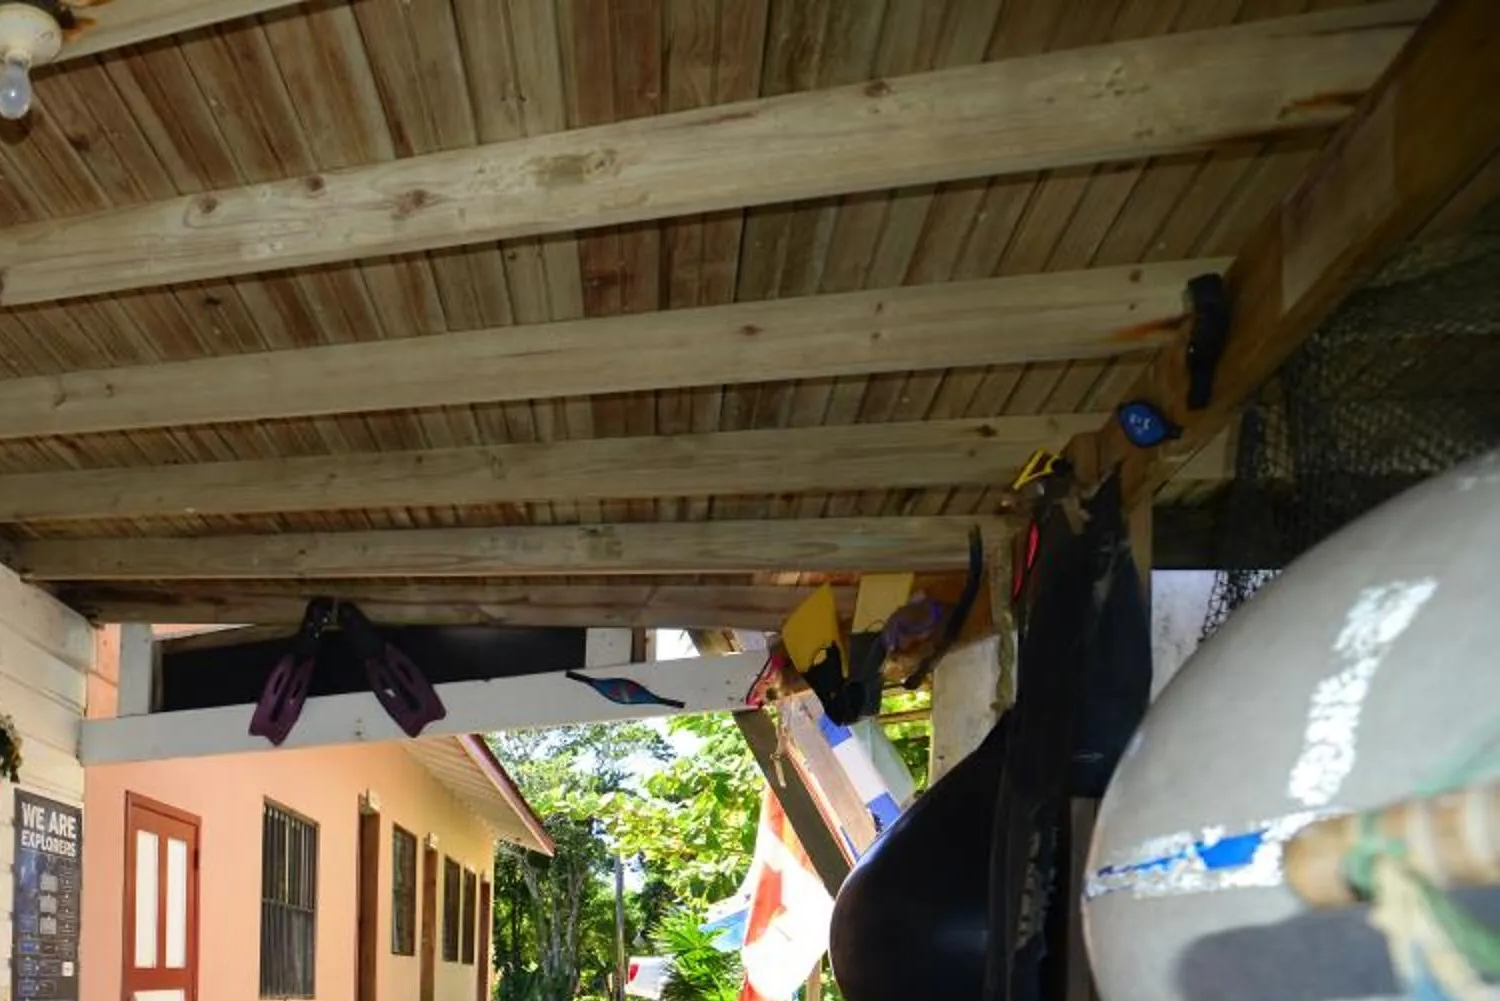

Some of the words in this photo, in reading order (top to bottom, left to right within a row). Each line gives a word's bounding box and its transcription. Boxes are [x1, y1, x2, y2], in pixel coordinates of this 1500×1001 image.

[21, 801, 45, 831] WE
[48, 810, 77, 839] ARE
[21, 828, 78, 857] EXPLORERS
